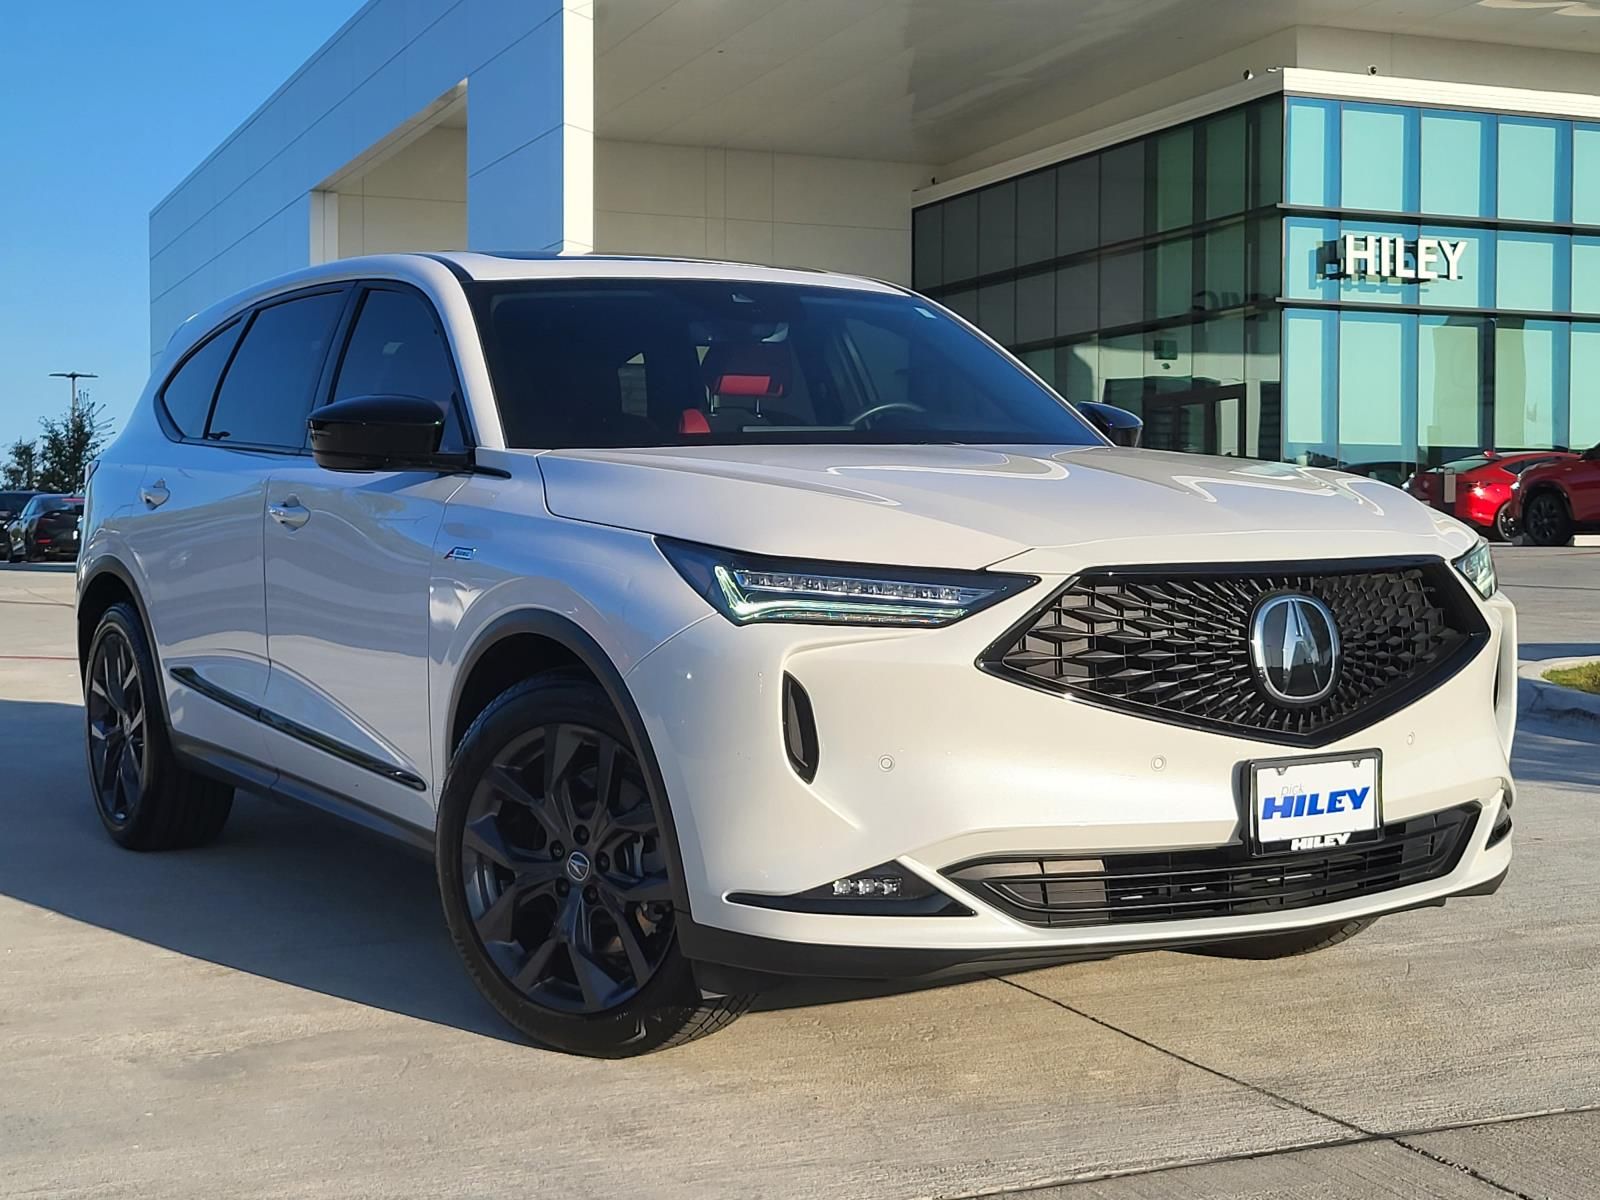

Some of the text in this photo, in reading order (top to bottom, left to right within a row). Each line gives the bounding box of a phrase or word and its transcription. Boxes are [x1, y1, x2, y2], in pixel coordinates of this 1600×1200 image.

[1345, 234, 1468, 280] HILEY
[1262, 786, 1371, 820] HILEY
[1290, 832, 1351, 850] HILEY
